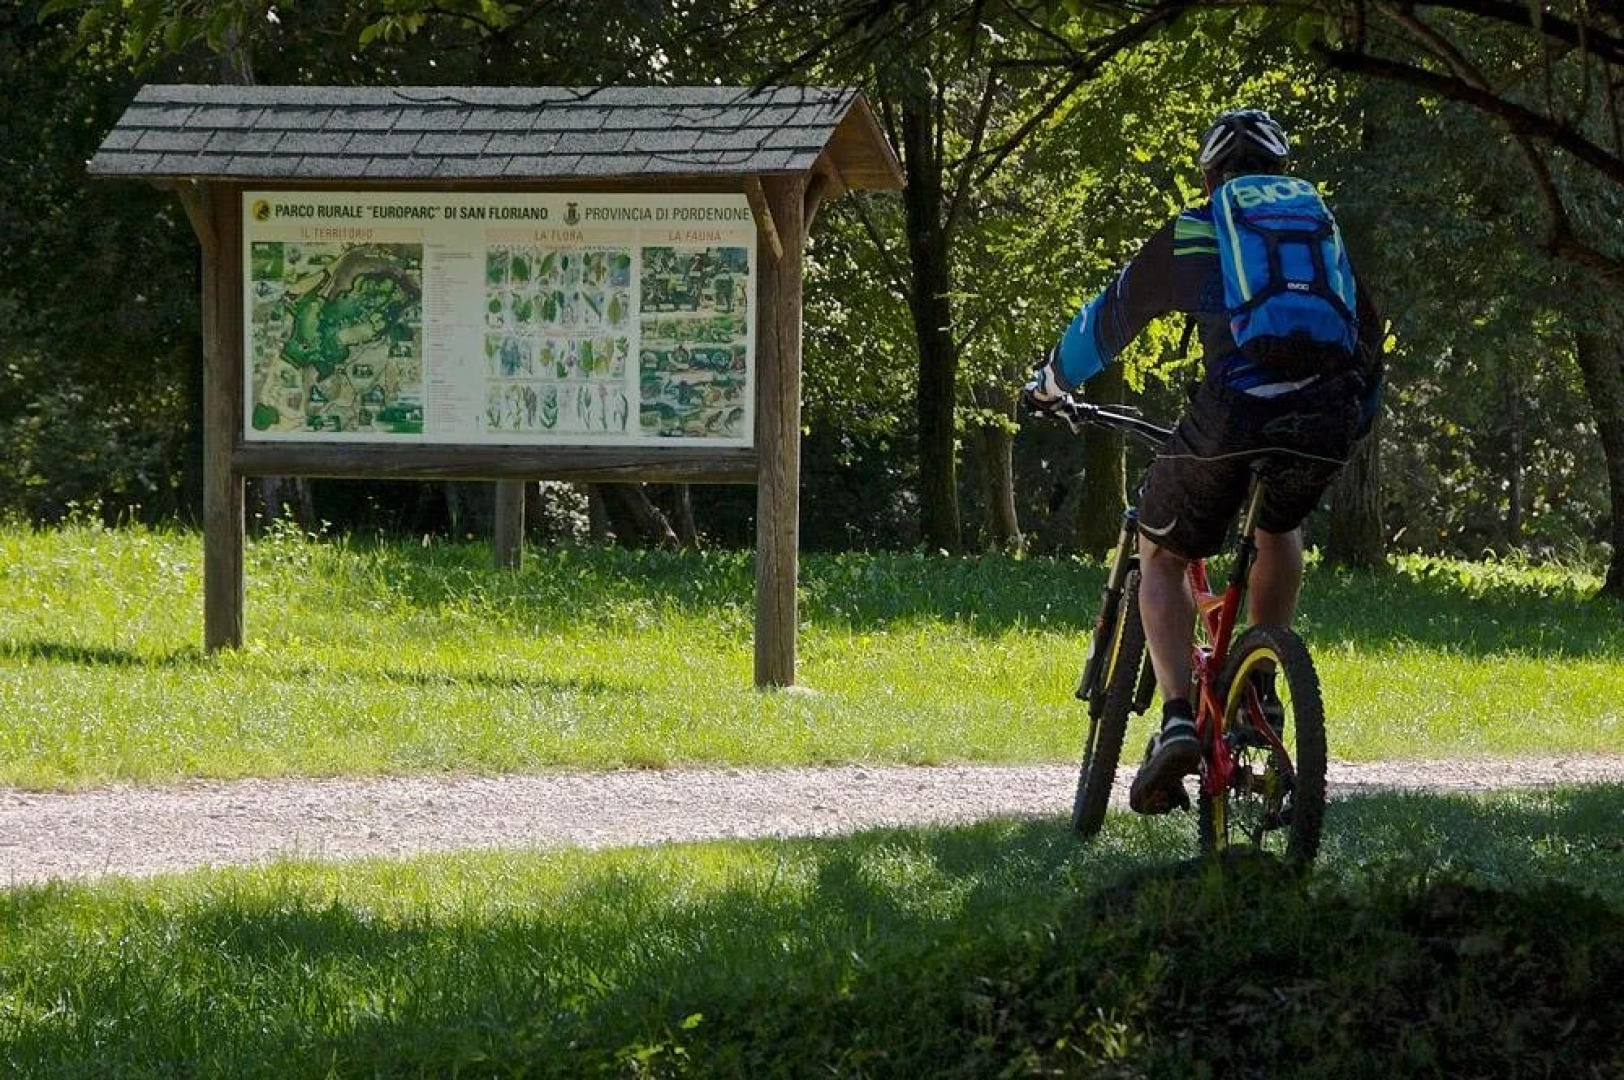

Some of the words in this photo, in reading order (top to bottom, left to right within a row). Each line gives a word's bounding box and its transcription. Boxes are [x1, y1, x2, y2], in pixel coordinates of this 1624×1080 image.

[275, 204, 314, 218] PARCO
[317, 205, 363, 219] RURALE
[444, 207, 457, 220] DI
[460, 207, 485, 220] SAN
[488, 207, 548, 220] FLORIANO
[585, 207, 652, 221] PROVINCIA
[656, 207, 668, 221] DI
[673, 207, 750, 221] PORDENONE
[314, 228, 373, 240] TERRITORIO
[535, 230, 547, 241] LA
[551, 230, 583, 242] FLORA
[668, 230, 681, 241] LA
[686, 230, 722, 241] FAUNA
